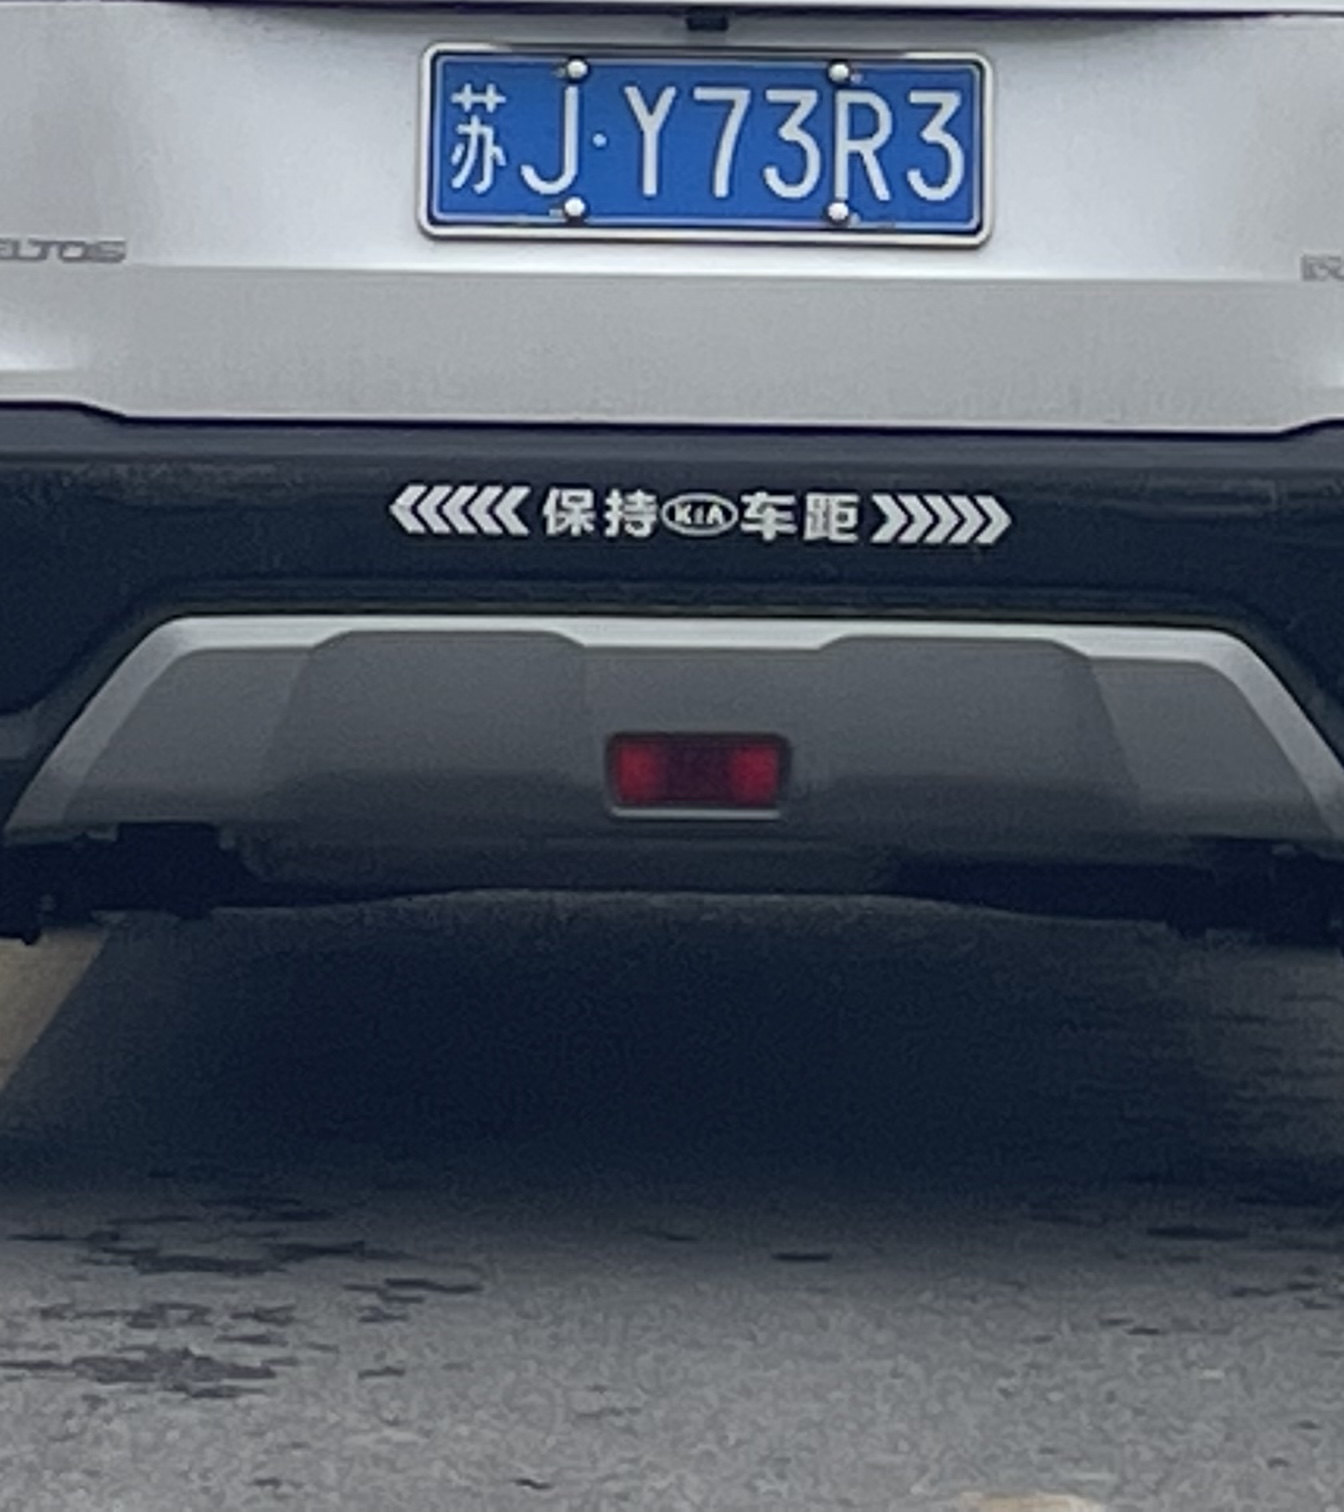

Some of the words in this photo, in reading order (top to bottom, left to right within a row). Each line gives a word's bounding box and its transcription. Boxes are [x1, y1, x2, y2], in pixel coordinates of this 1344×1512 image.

[449, 82, 965, 203] 苏J·Y73R3
[543, 489, 658, 538] 保持
[740, 491, 860, 543] 车距
